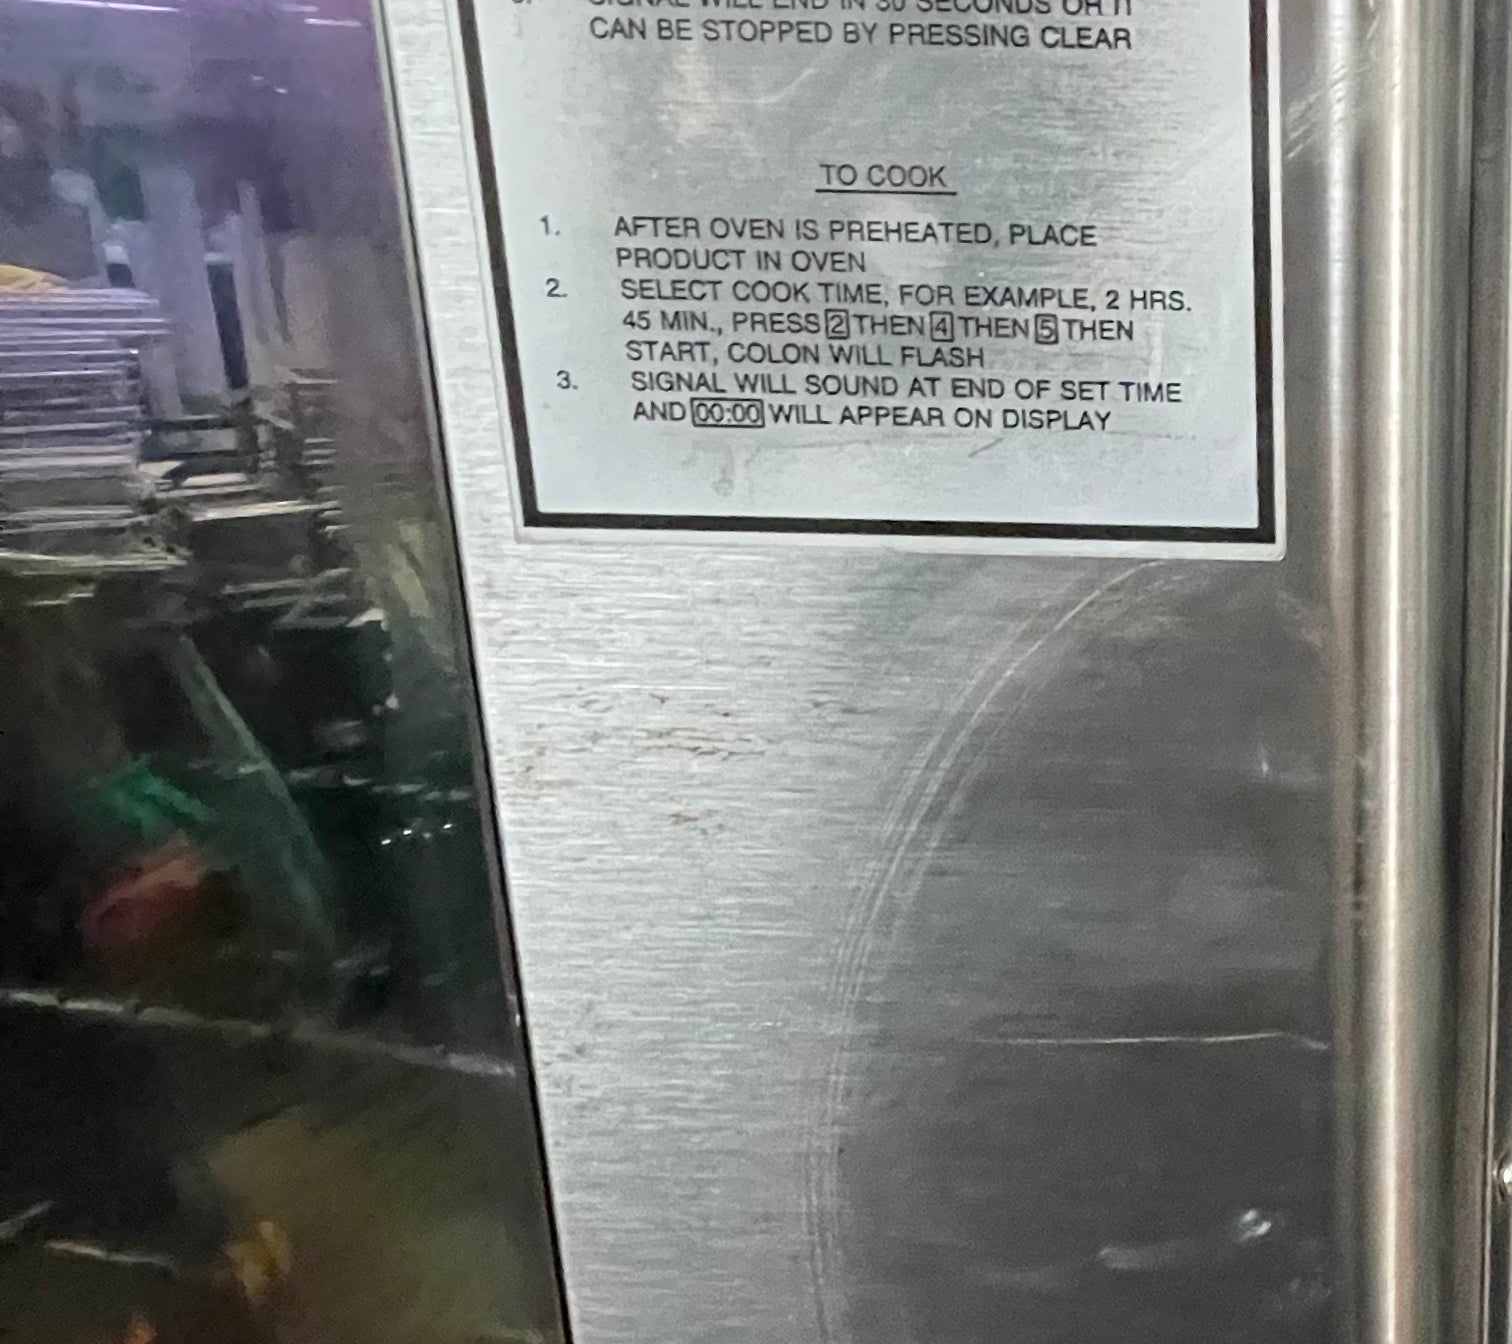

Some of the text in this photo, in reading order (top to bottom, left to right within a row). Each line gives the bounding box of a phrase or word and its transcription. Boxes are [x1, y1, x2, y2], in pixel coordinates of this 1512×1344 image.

[590, 17, 1131, 49] CAN BE STOPPED BY PRESSING CLEAR
[820, 164, 947, 188] TO COOK
[540, 215, 1098, 247] 1. AFTER OVEN IS PREHEATED, PLACE
[616, 248, 866, 273] PRODUCT IN OVEN
[546, 278, 1192, 313] 2. SELECT COOK TIME, FOR EXAMPLE, 2 HRS.
[622, 311, 1133, 340] 45 MIN., PRESS THEN THEN THEN
[626, 341, 985, 367] START, COLON WILL FLASH
[556, 370, 1183, 402] 3. SIGNAL WILL SOUND AT END OF SET TIME
[633, 401, 1112, 431] AND 00:00 WILL APPEAR ON DISPLAY
